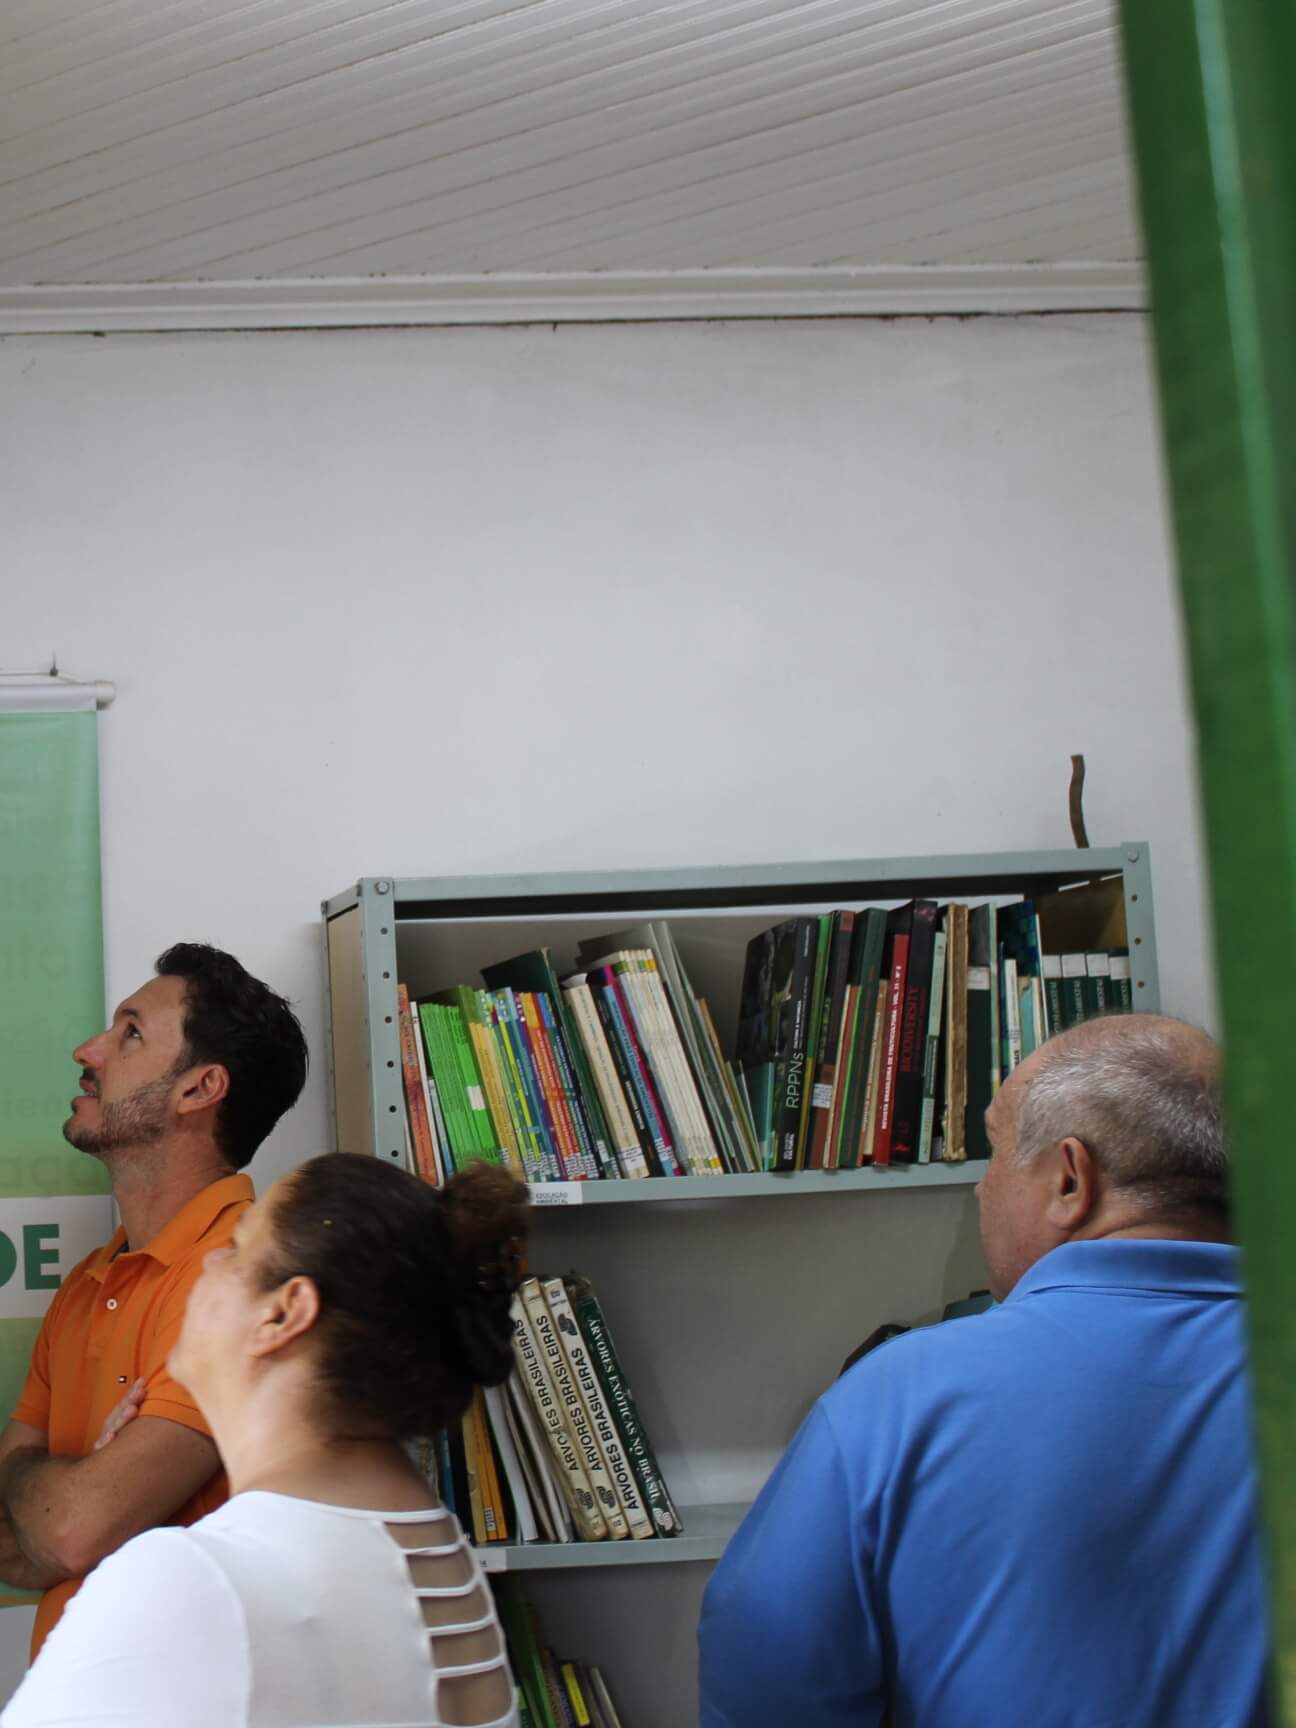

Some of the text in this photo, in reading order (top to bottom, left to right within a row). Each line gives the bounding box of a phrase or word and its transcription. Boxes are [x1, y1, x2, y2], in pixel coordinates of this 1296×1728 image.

[785, 1052, 804, 1109] RPPNs
[536, 1314, 577, 1408] BRASILEIRAS
[587, 1318, 615, 1374] ÁRVORES
[514, 1319, 579, 1471] ARVOES BRASILEIRAS
[571, 1346, 614, 1444] BRASILEIRAS
[630, 1439, 645, 1457] NO
[637, 1458, 662, 1502] BRASIL
